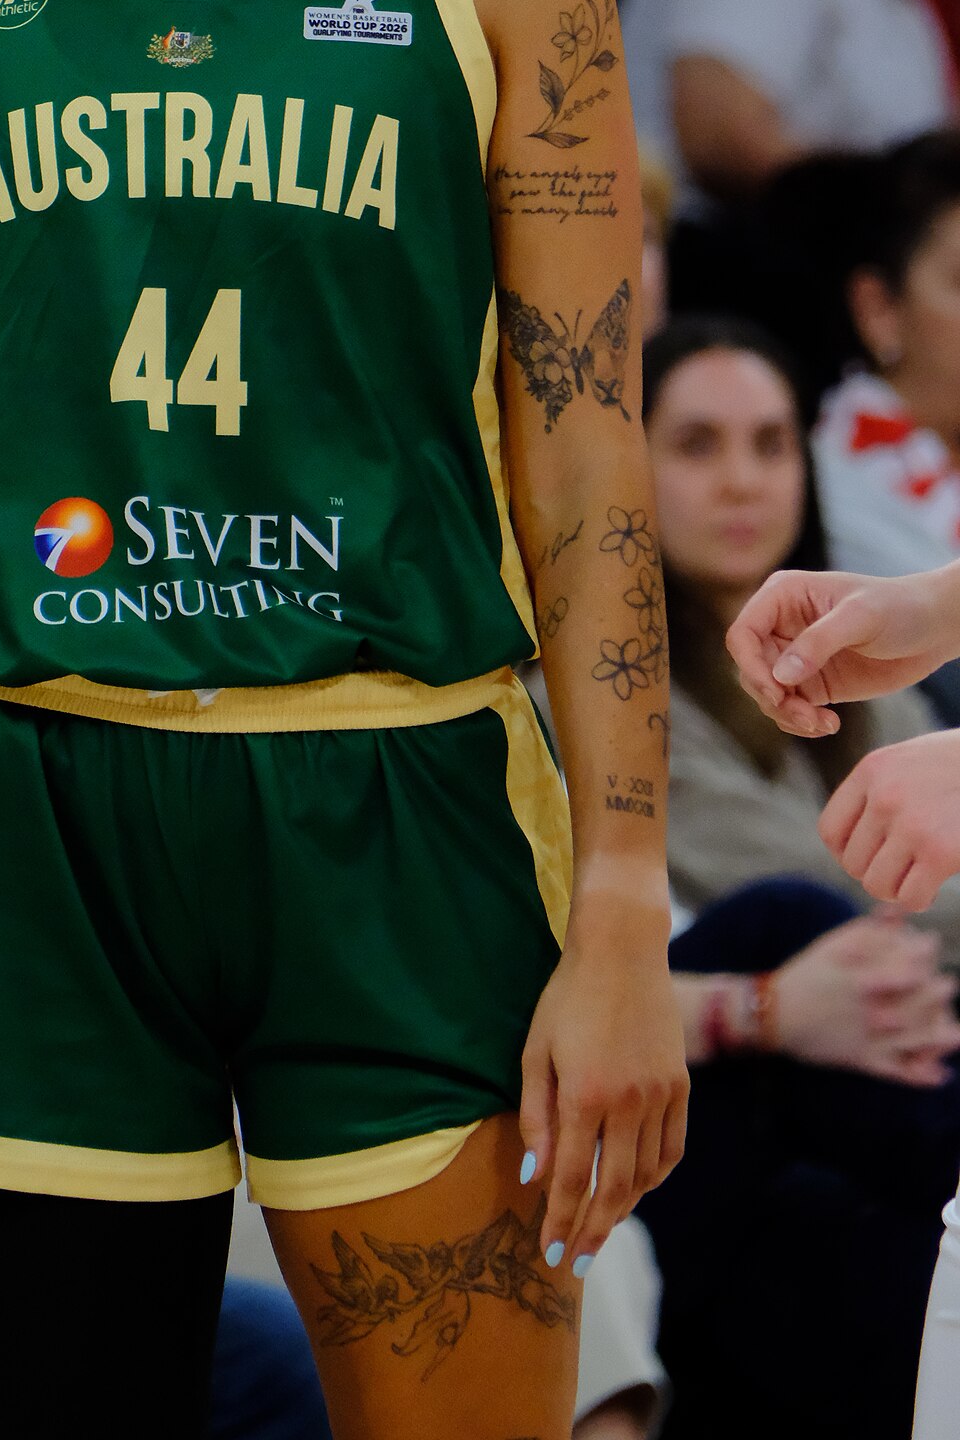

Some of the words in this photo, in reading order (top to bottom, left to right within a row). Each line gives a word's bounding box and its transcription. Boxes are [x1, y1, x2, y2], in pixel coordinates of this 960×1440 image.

[308, 12, 350, 20] WOMEN'S
[353, 15, 408, 24] BASKETBALL
[308, 19, 351, 29] WORLD
[354, 21, 377, 31] CUP
[379, 23, 408, 33] 2026
[312, 28, 352, 37] QUALIFYING
[354, 30, 403, 41] TOURNAMENTS
[109, 287, 248, 437] 44
[33, 579, 344, 626] CONSULTING
